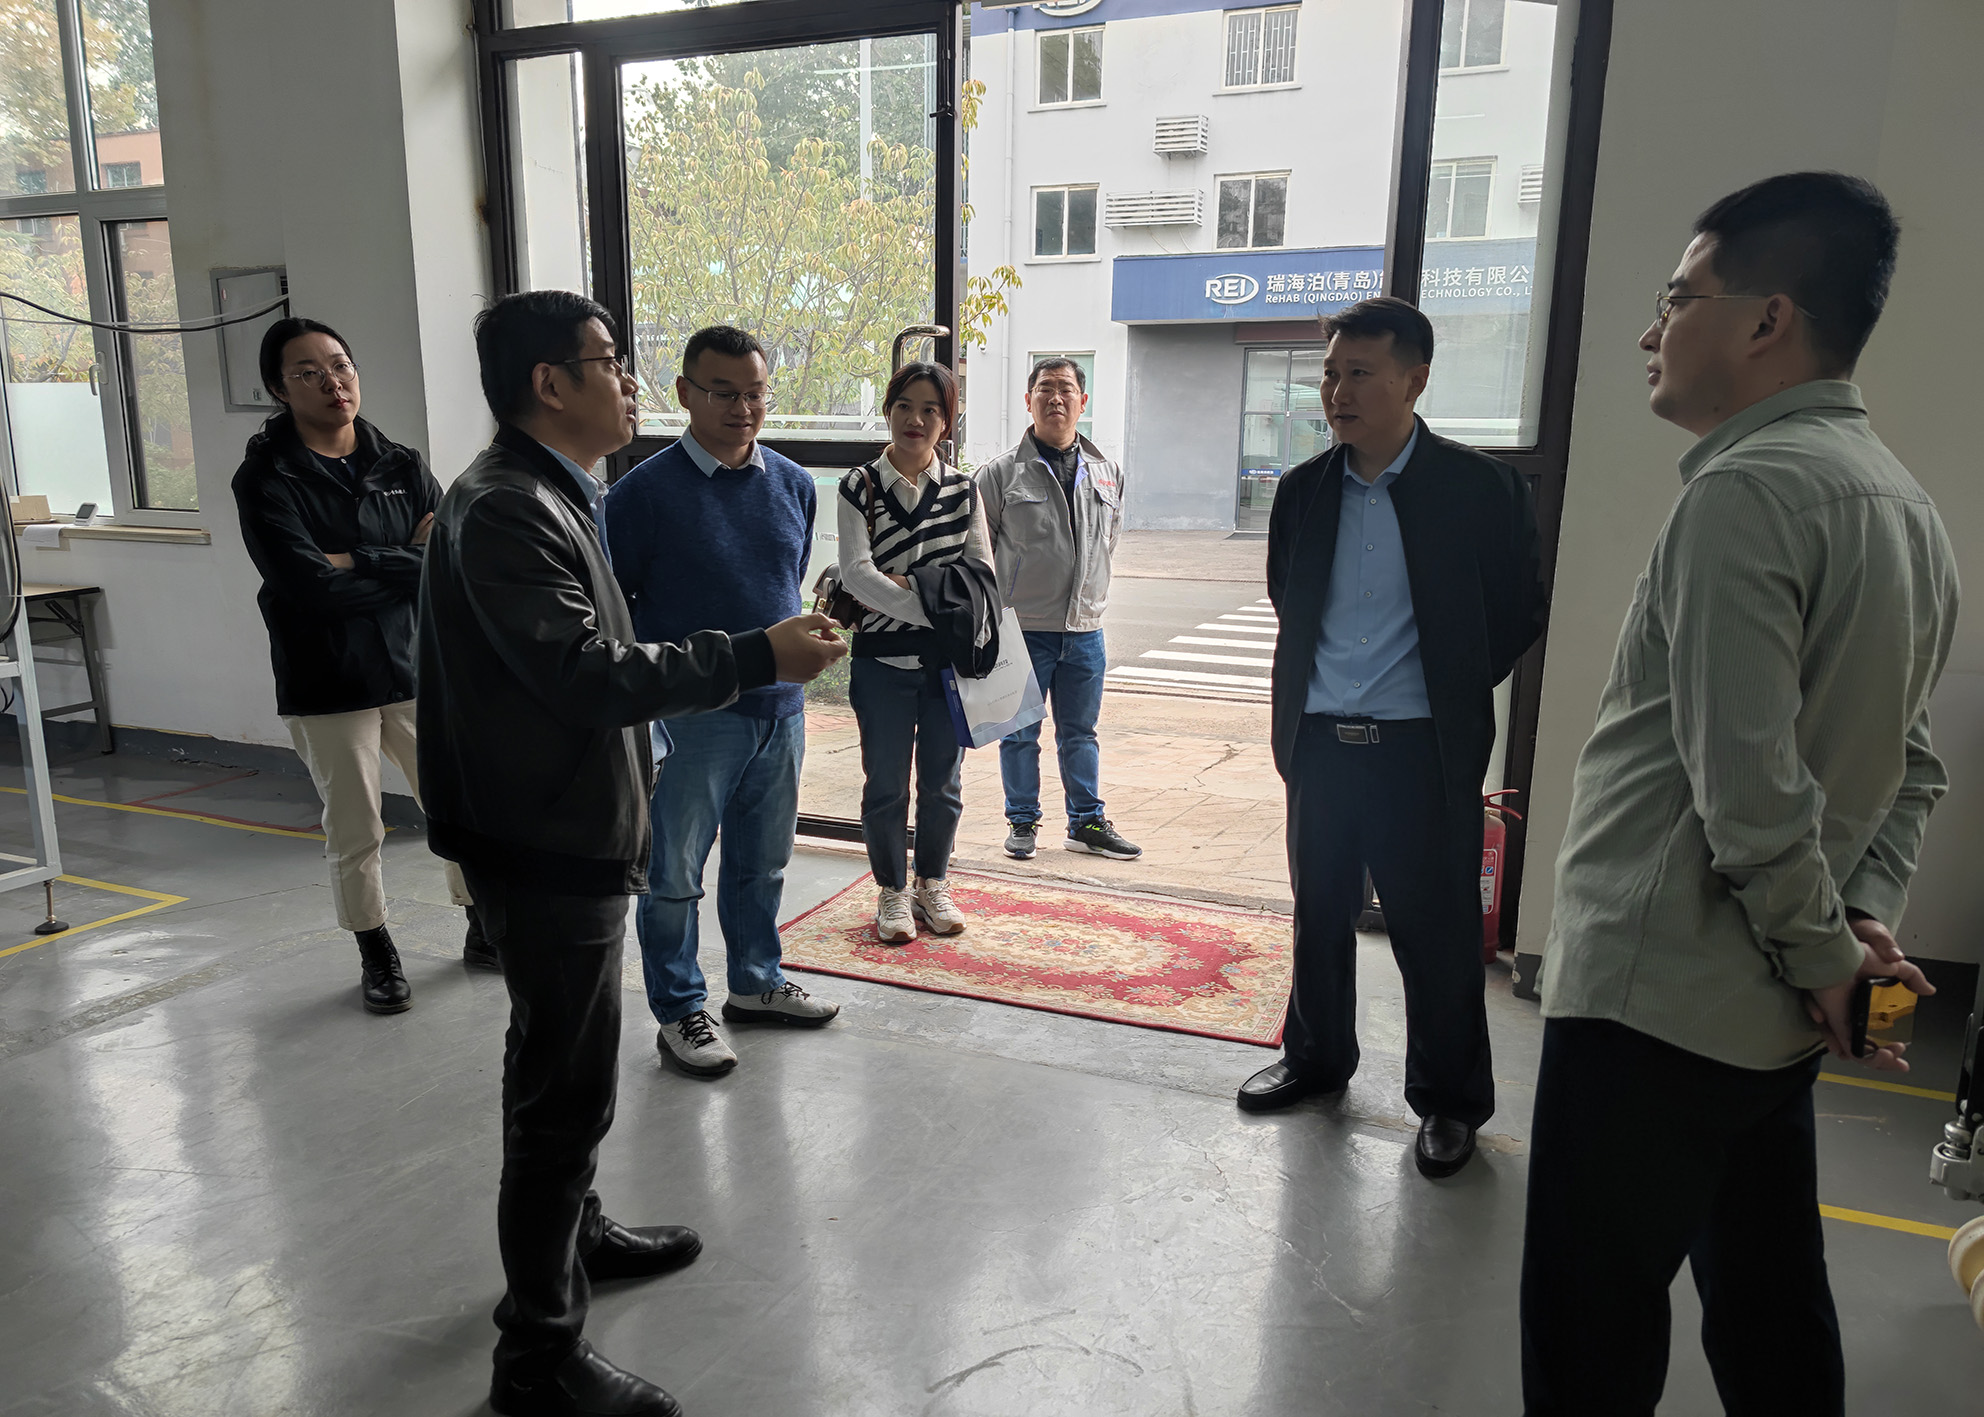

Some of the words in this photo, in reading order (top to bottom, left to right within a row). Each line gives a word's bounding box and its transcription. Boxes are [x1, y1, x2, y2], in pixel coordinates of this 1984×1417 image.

[1205, 278, 1247, 299] REI
[1265, 292, 1300, 304] ReHAB
[1303, 290, 1363, 304] (QINGDAO)
[1366, 290, 1382, 300] EN
[1421, 287, 1492, 299] ECHNOLOGY
